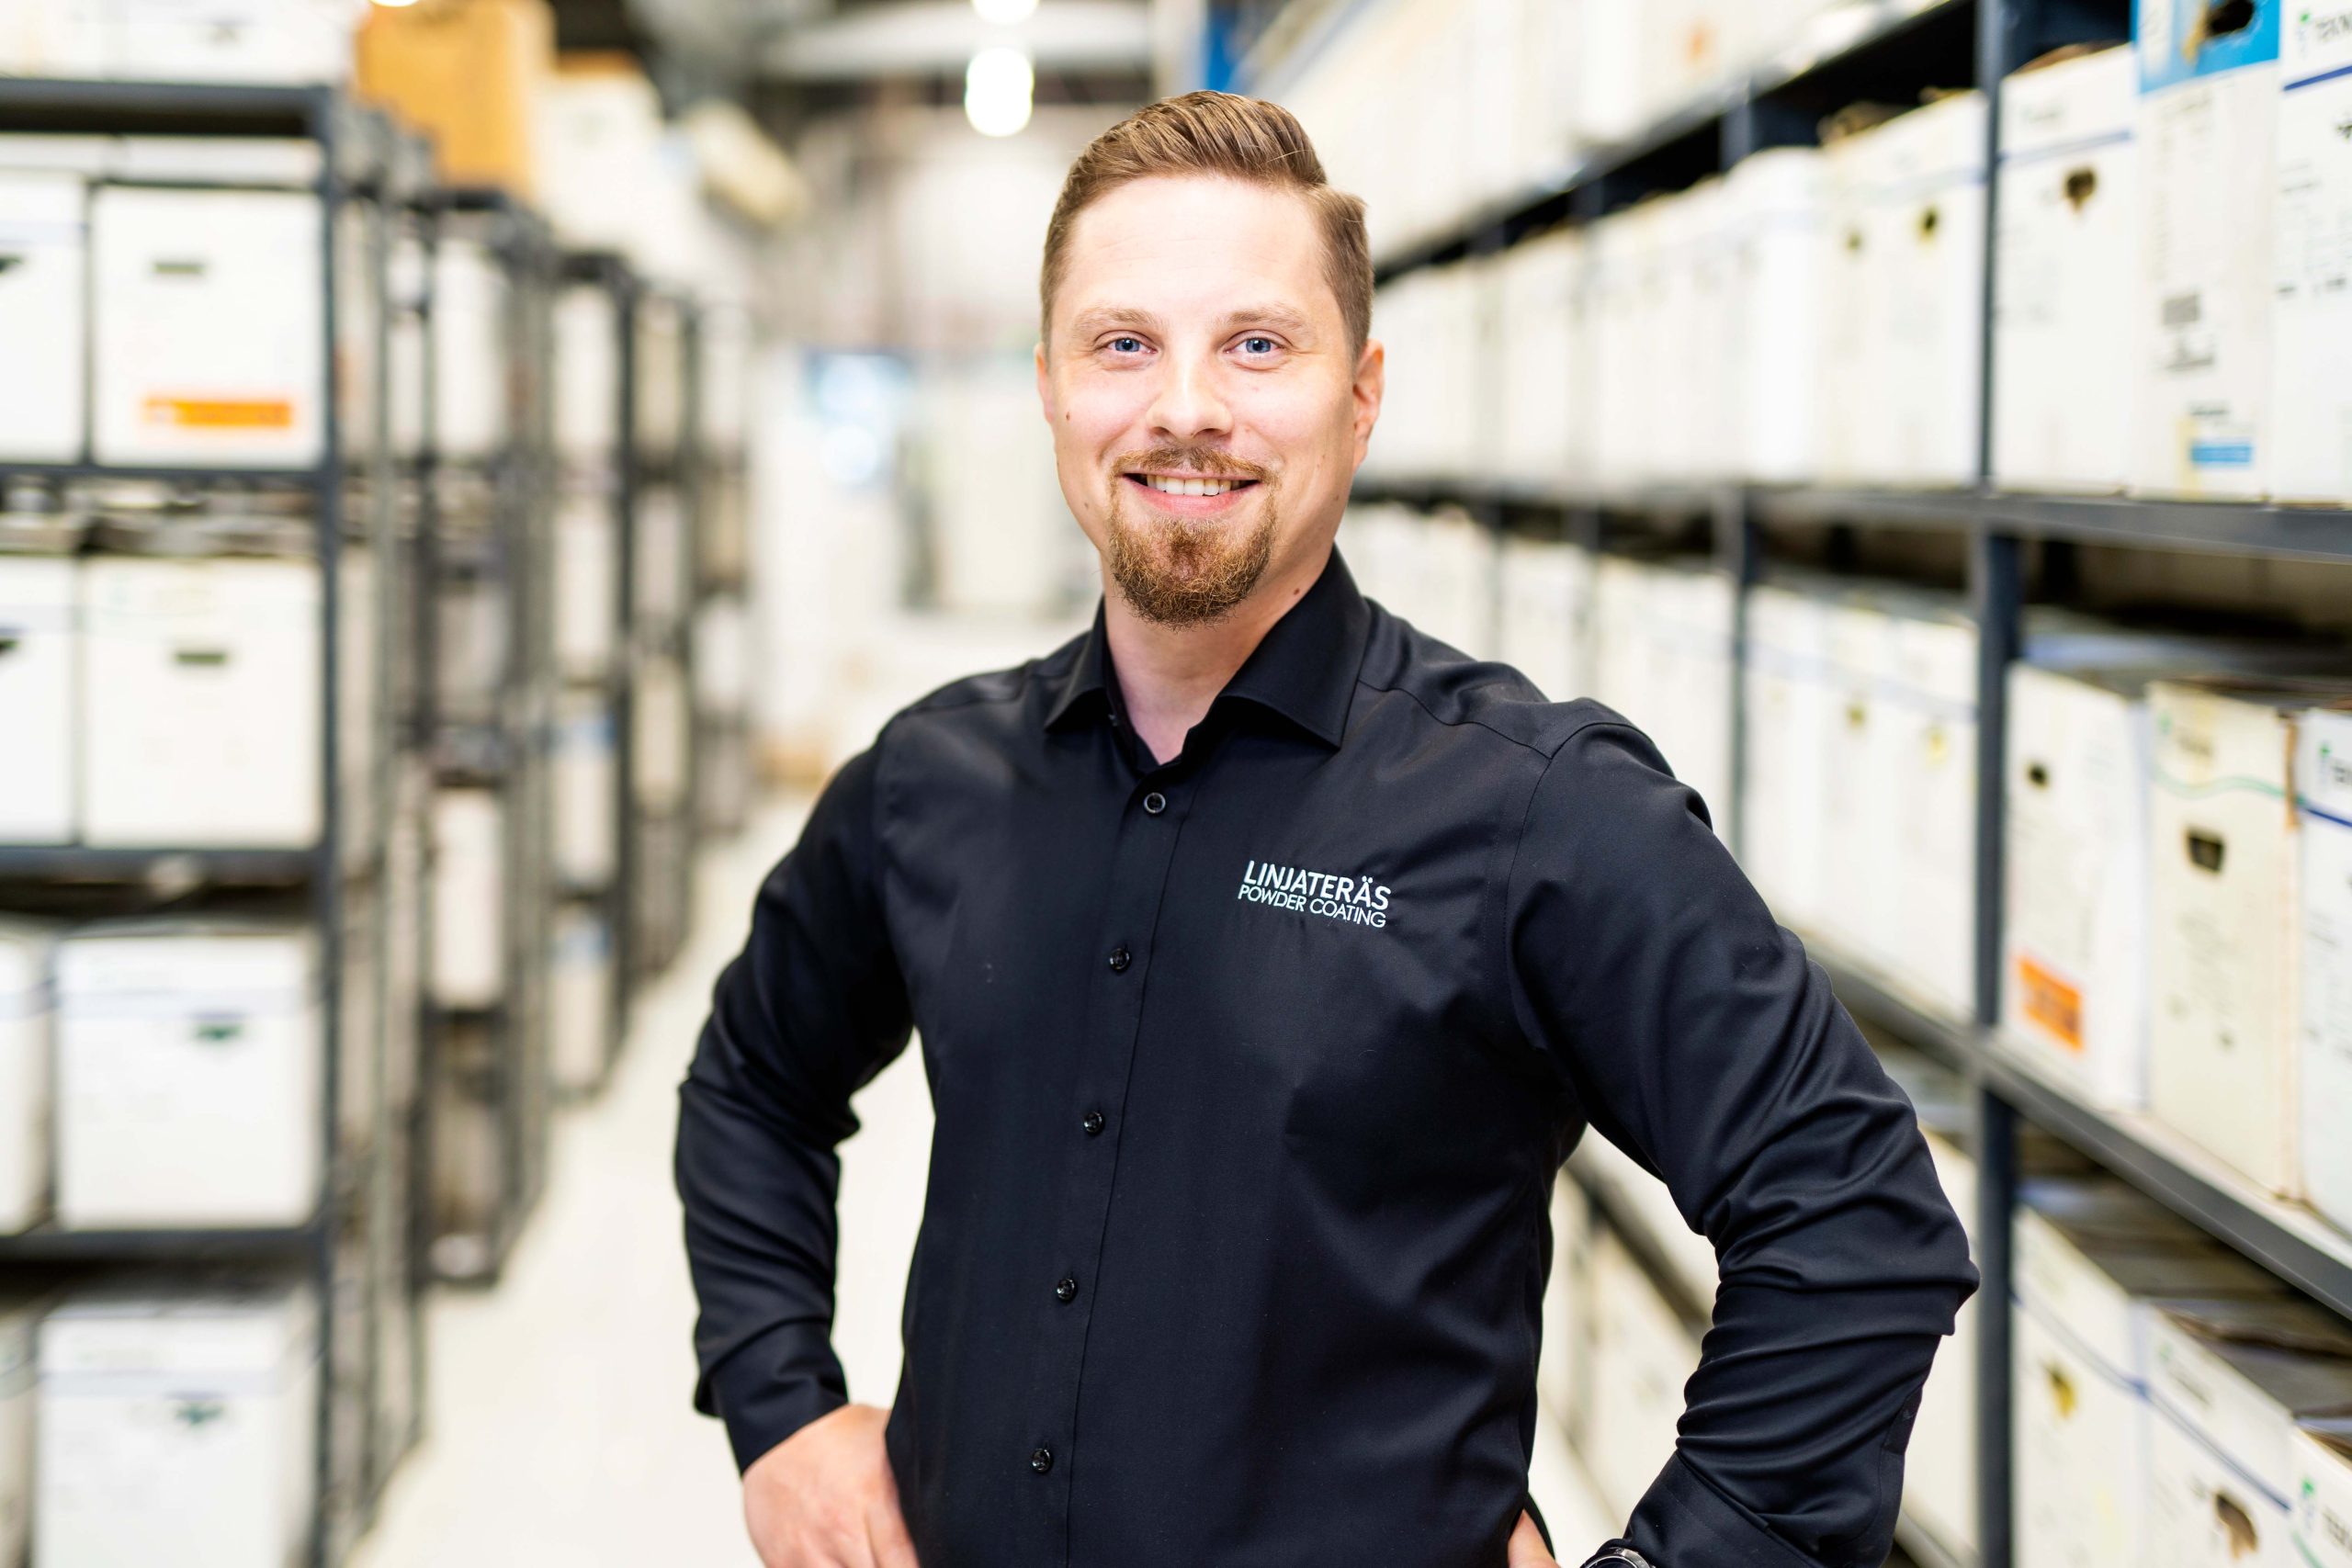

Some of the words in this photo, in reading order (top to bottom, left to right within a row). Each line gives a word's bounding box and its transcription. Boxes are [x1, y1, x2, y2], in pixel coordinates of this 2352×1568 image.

[1238, 885, 1306, 912] POWDER
[1309, 898, 1386, 928] COATING
[1243, 860, 1391, 910] LINJATERÄS
